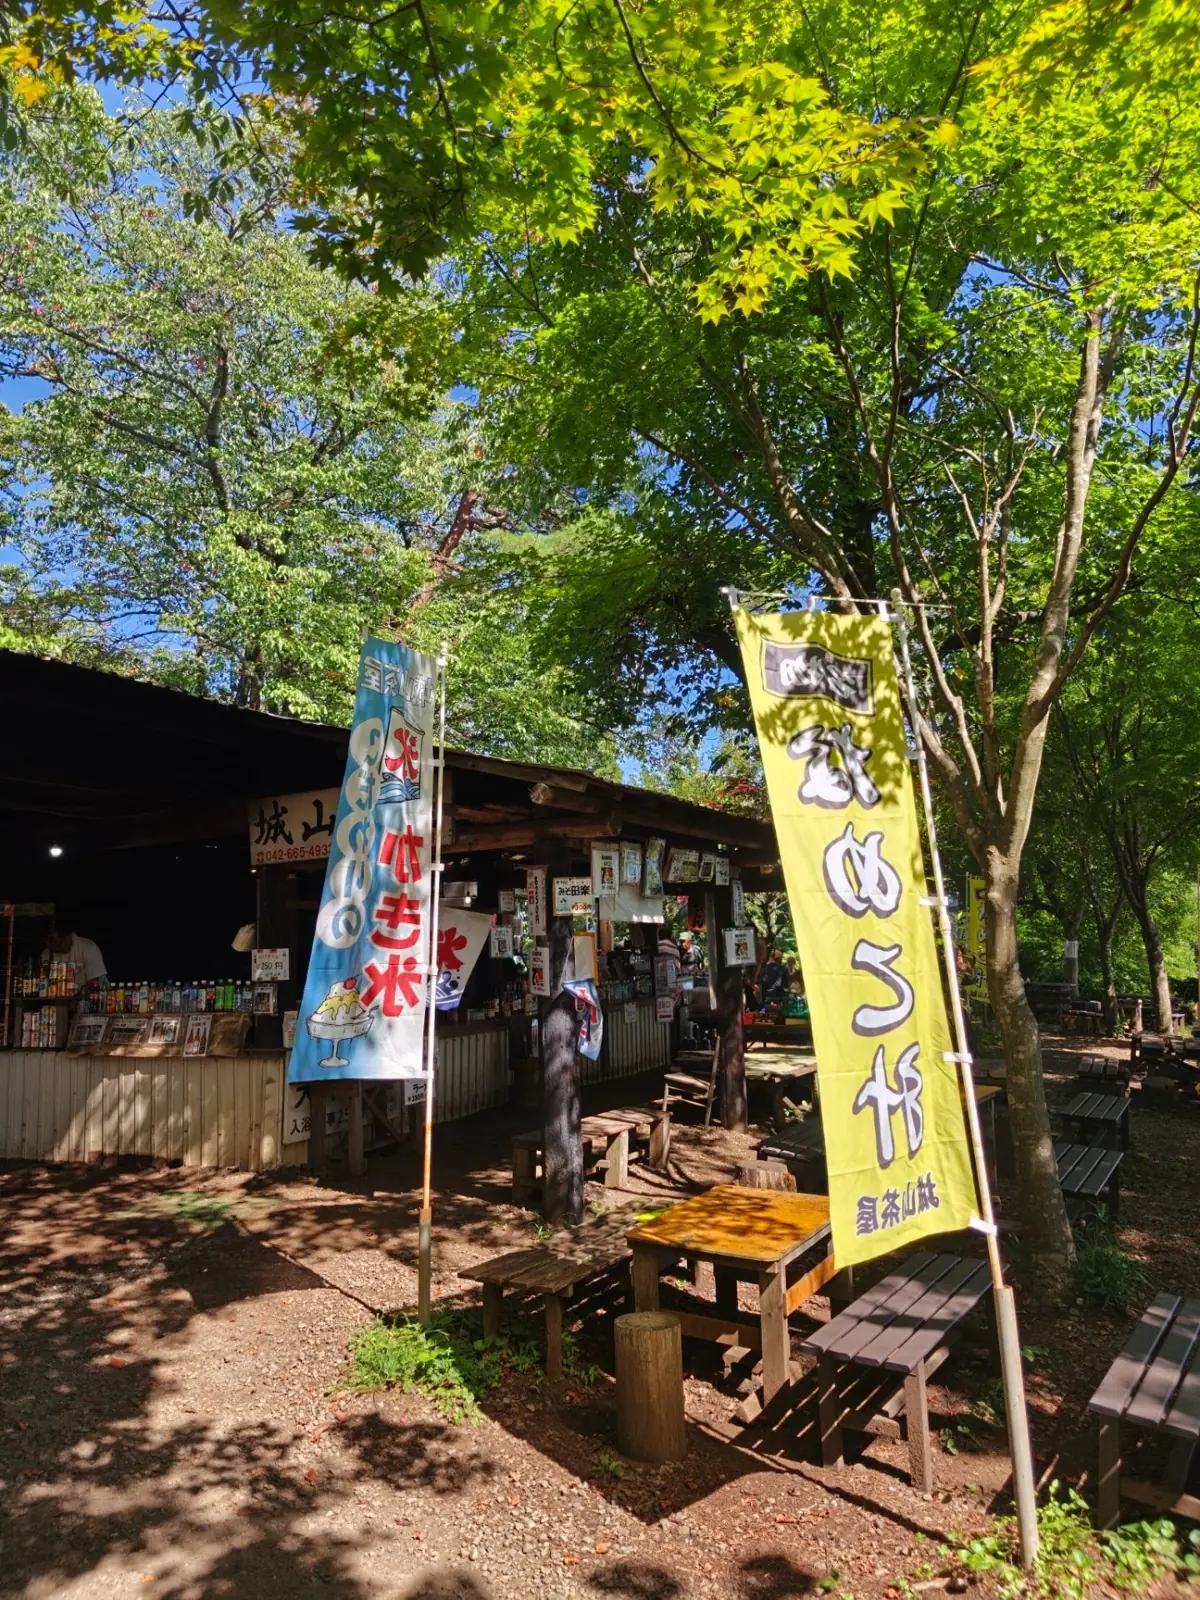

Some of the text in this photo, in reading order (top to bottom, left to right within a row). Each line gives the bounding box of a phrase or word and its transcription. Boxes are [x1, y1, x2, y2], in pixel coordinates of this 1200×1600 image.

[253, 799, 336, 845] 城山
[265, 844, 331, 862] 042-665-493
[558, 885, 590, 896] みそ田楽
